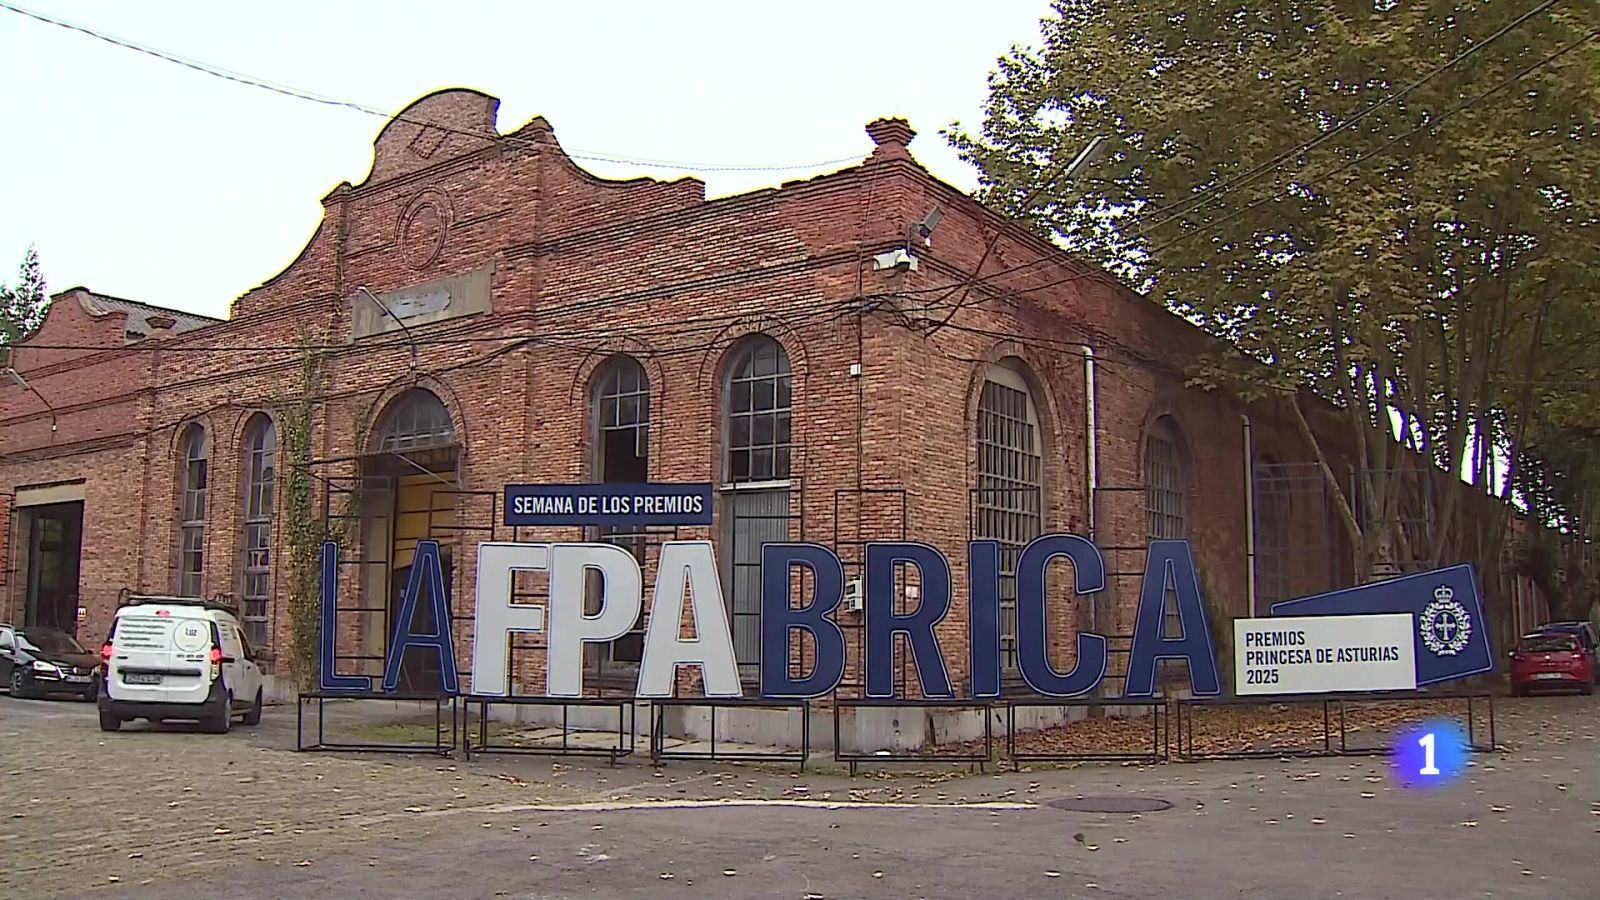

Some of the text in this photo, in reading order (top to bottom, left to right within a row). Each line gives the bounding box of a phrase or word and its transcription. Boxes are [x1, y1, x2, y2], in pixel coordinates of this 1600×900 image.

[514, 495, 703, 514] SEMANA DE LOS PREMIOS
[1246, 631, 1305, 646] PREMIOS
[1246, 646, 1399, 665] PRINCESA DE ASTURIAS
[1247, 669, 1279, 684] 2025
